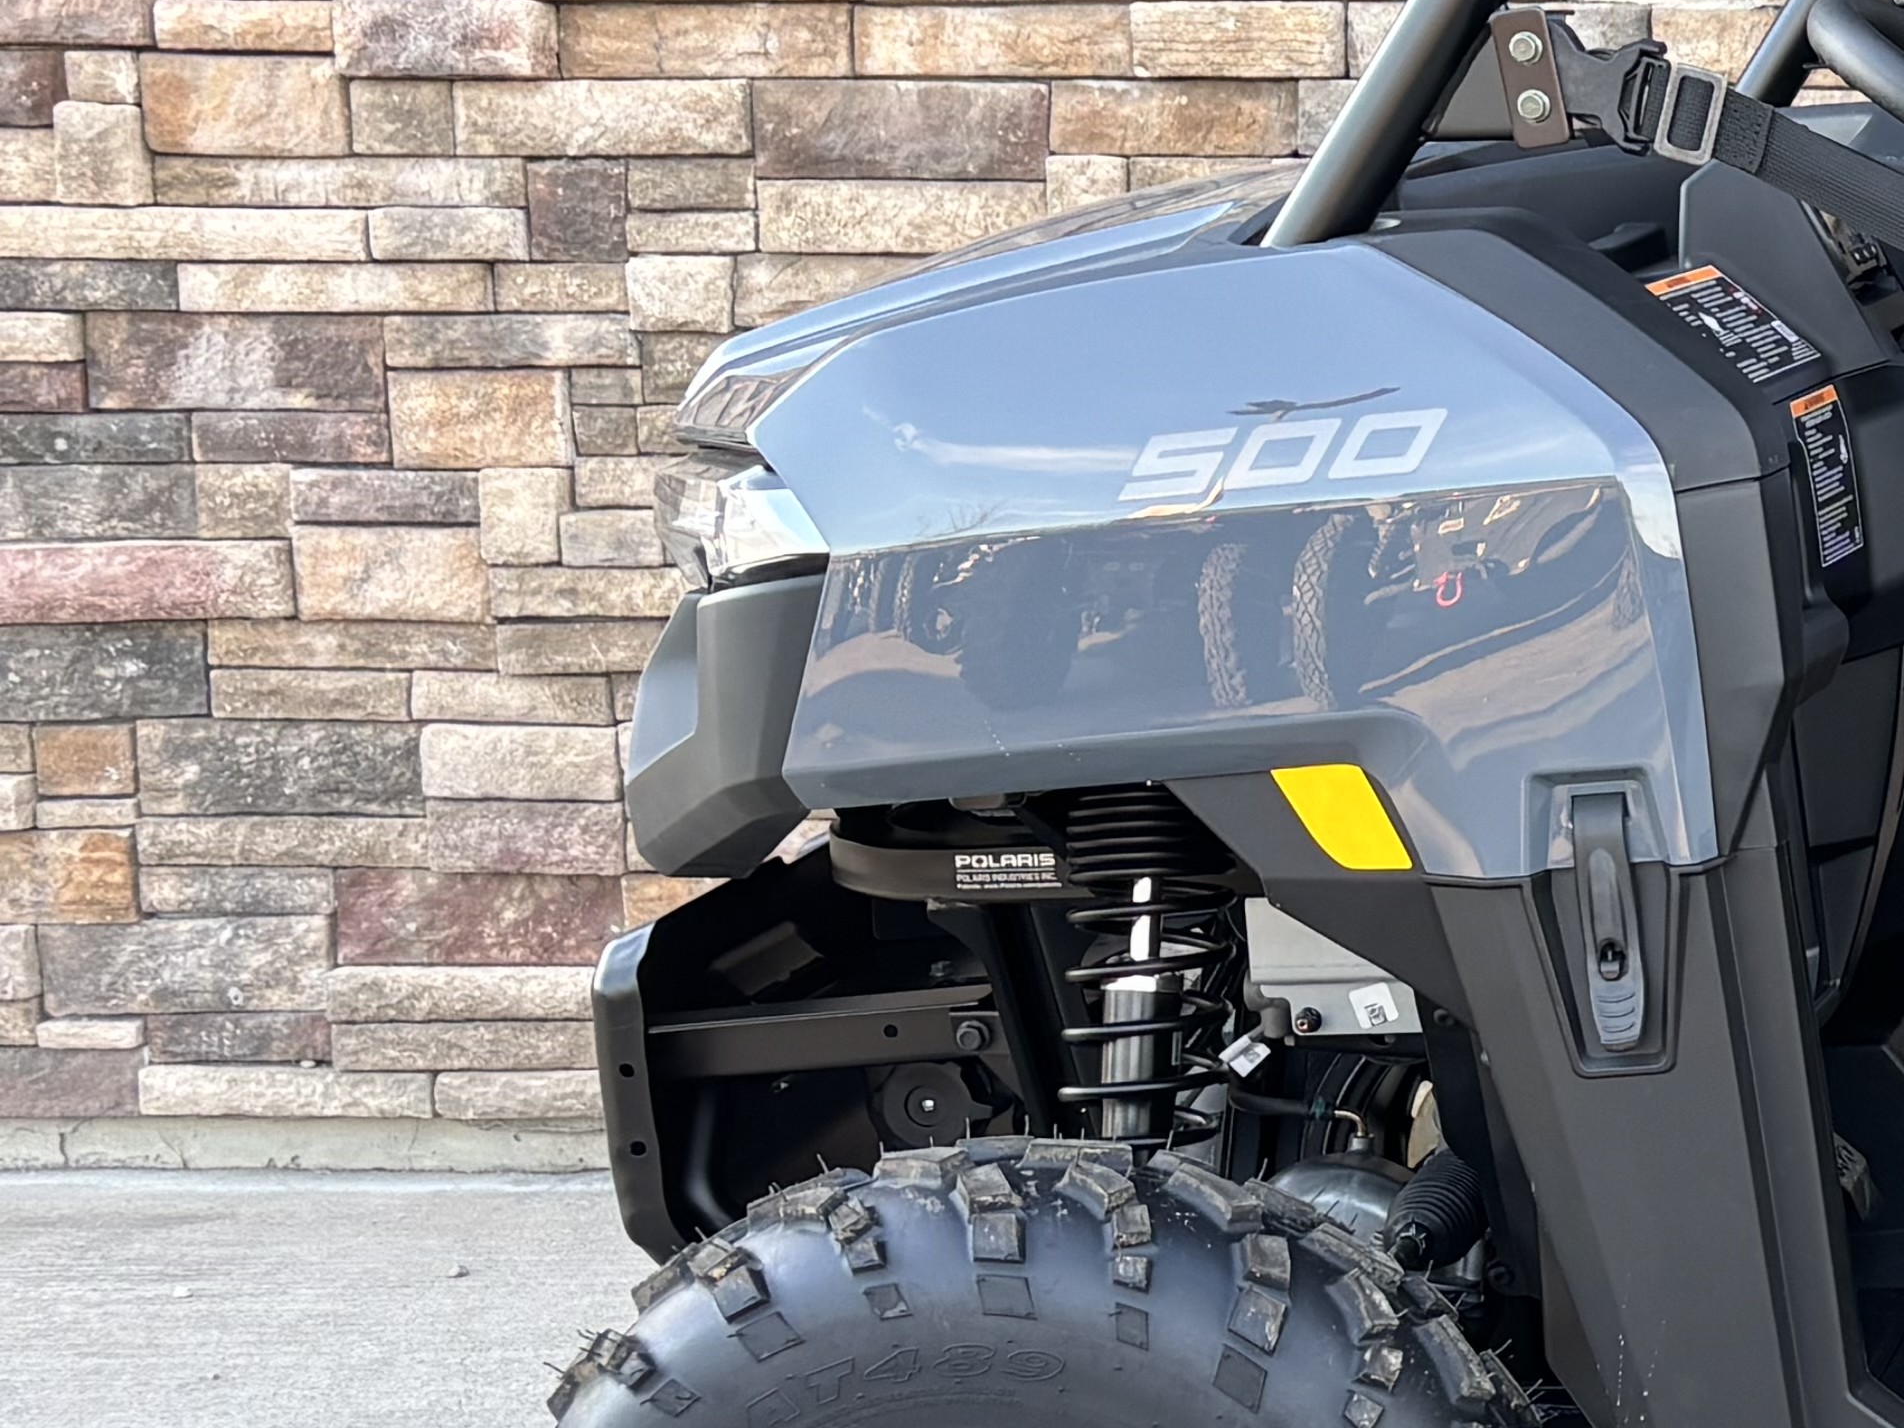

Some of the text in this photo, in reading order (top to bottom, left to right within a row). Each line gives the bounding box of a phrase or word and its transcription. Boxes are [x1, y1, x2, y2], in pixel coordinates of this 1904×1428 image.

[1117, 408, 1449, 501] 500
[954, 853, 1056, 868] POLARIS
[956, 874, 991, 882] POLARIS
